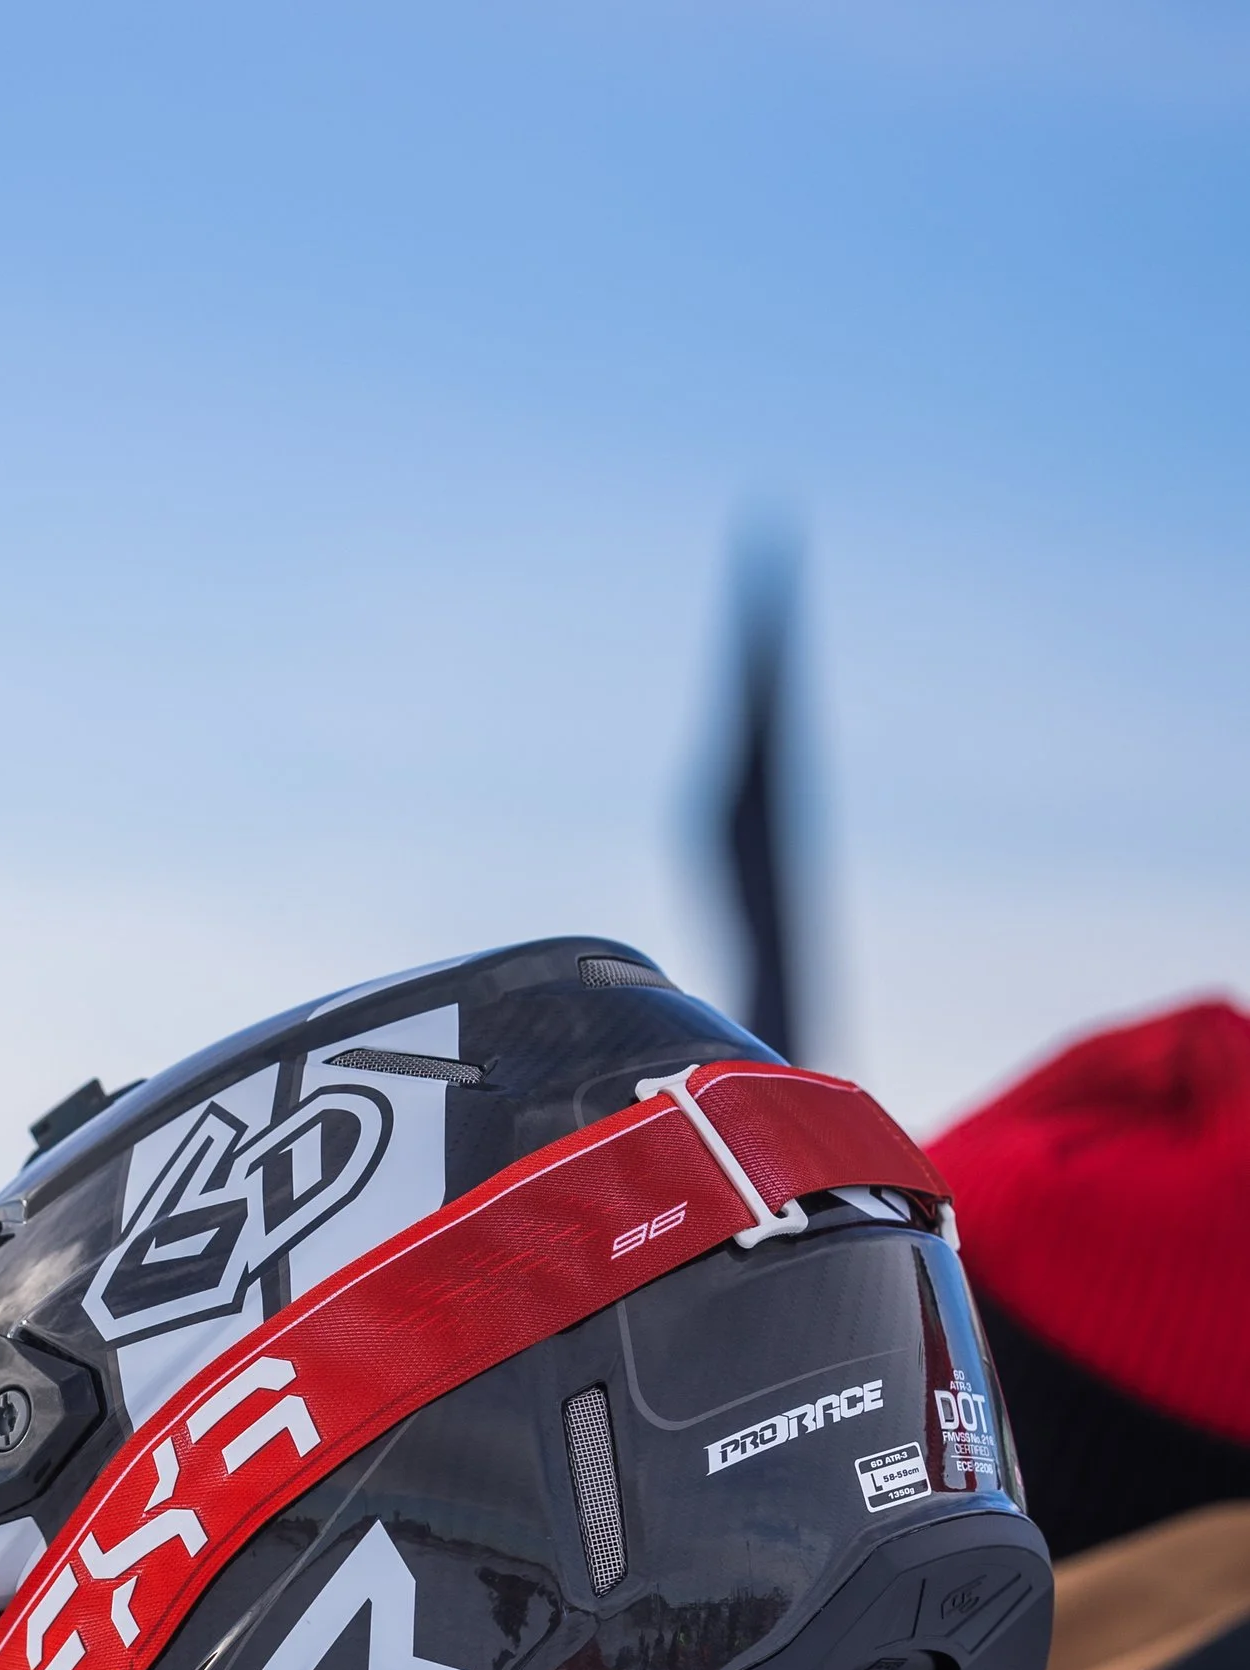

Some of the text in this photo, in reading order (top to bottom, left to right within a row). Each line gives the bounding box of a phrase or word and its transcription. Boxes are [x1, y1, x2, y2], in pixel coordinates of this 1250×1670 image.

[81, 1084, 394, 1347] 6D
[953, 1369, 965, 1381] 6D
[950, 1380, 972, 1393] ATR-3
[934, 1389, 988, 1434] DOT
[870, 1451, 908, 1468] 6D ATR-3
[870, 1466, 920, 1493] L 58-59cm
[888, 1486, 915, 1501] 1350g
